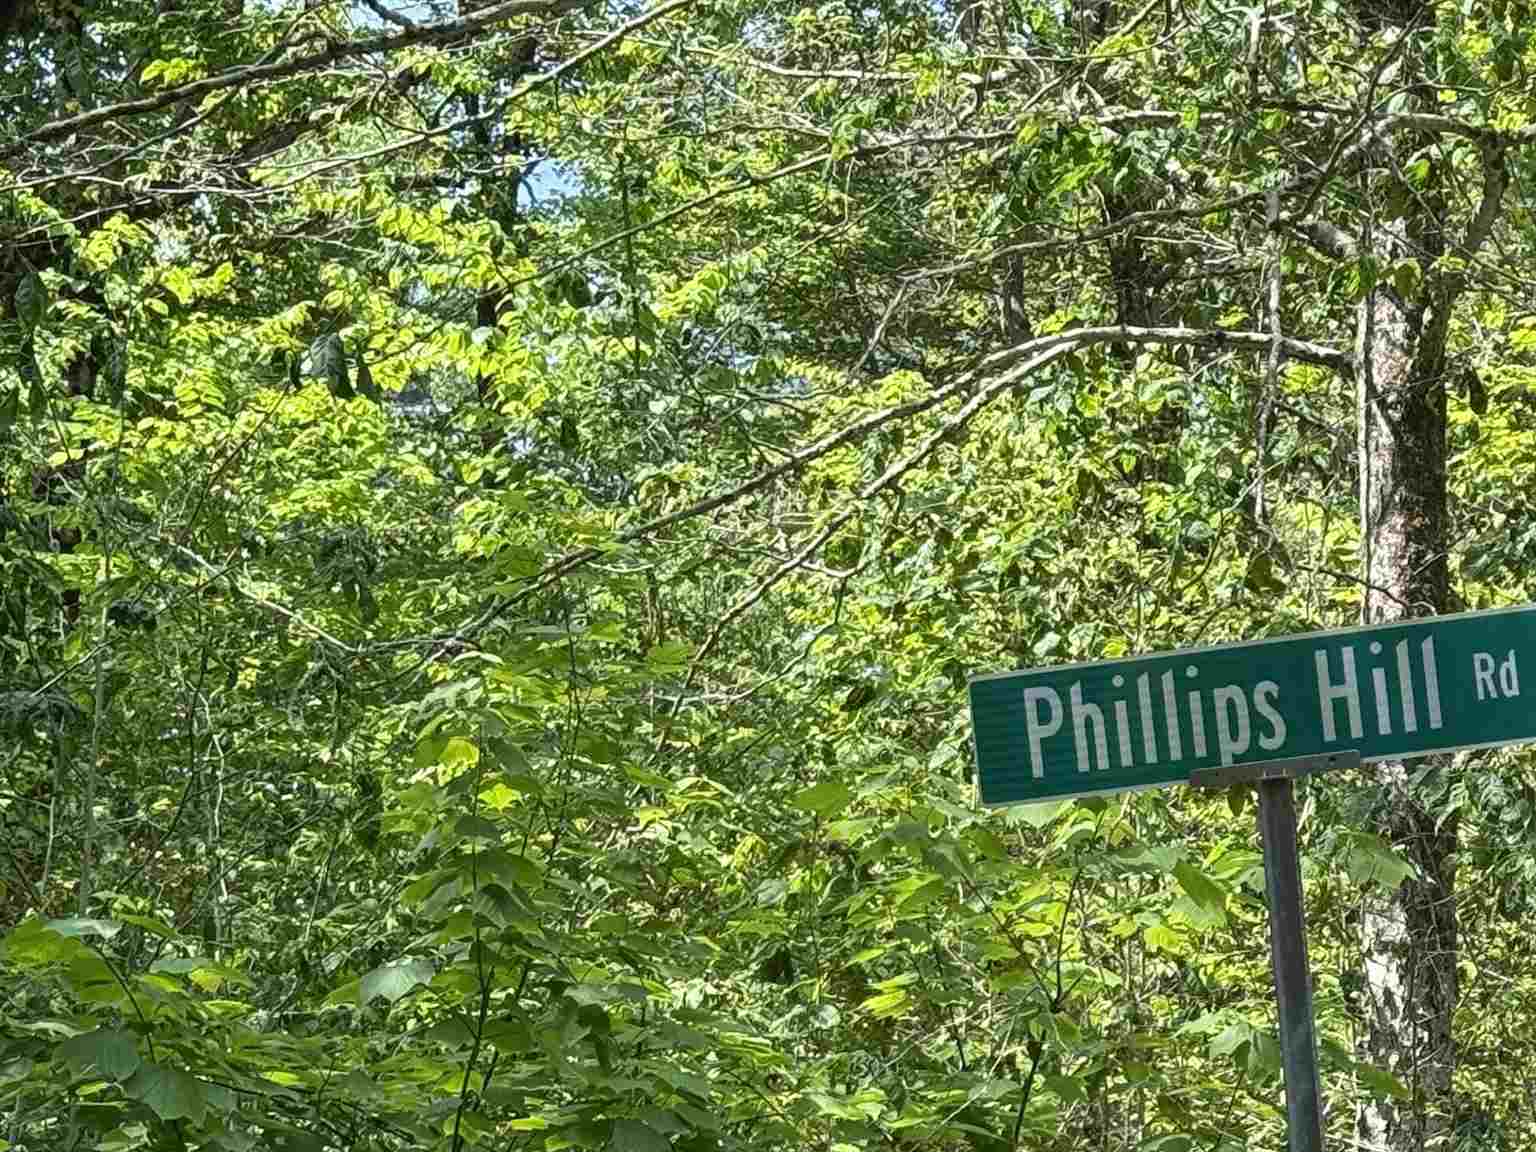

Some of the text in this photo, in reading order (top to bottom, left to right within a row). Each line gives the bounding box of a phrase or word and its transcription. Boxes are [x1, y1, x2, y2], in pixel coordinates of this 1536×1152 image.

[1024, 635, 1520, 778] Phillips Hill Rd
